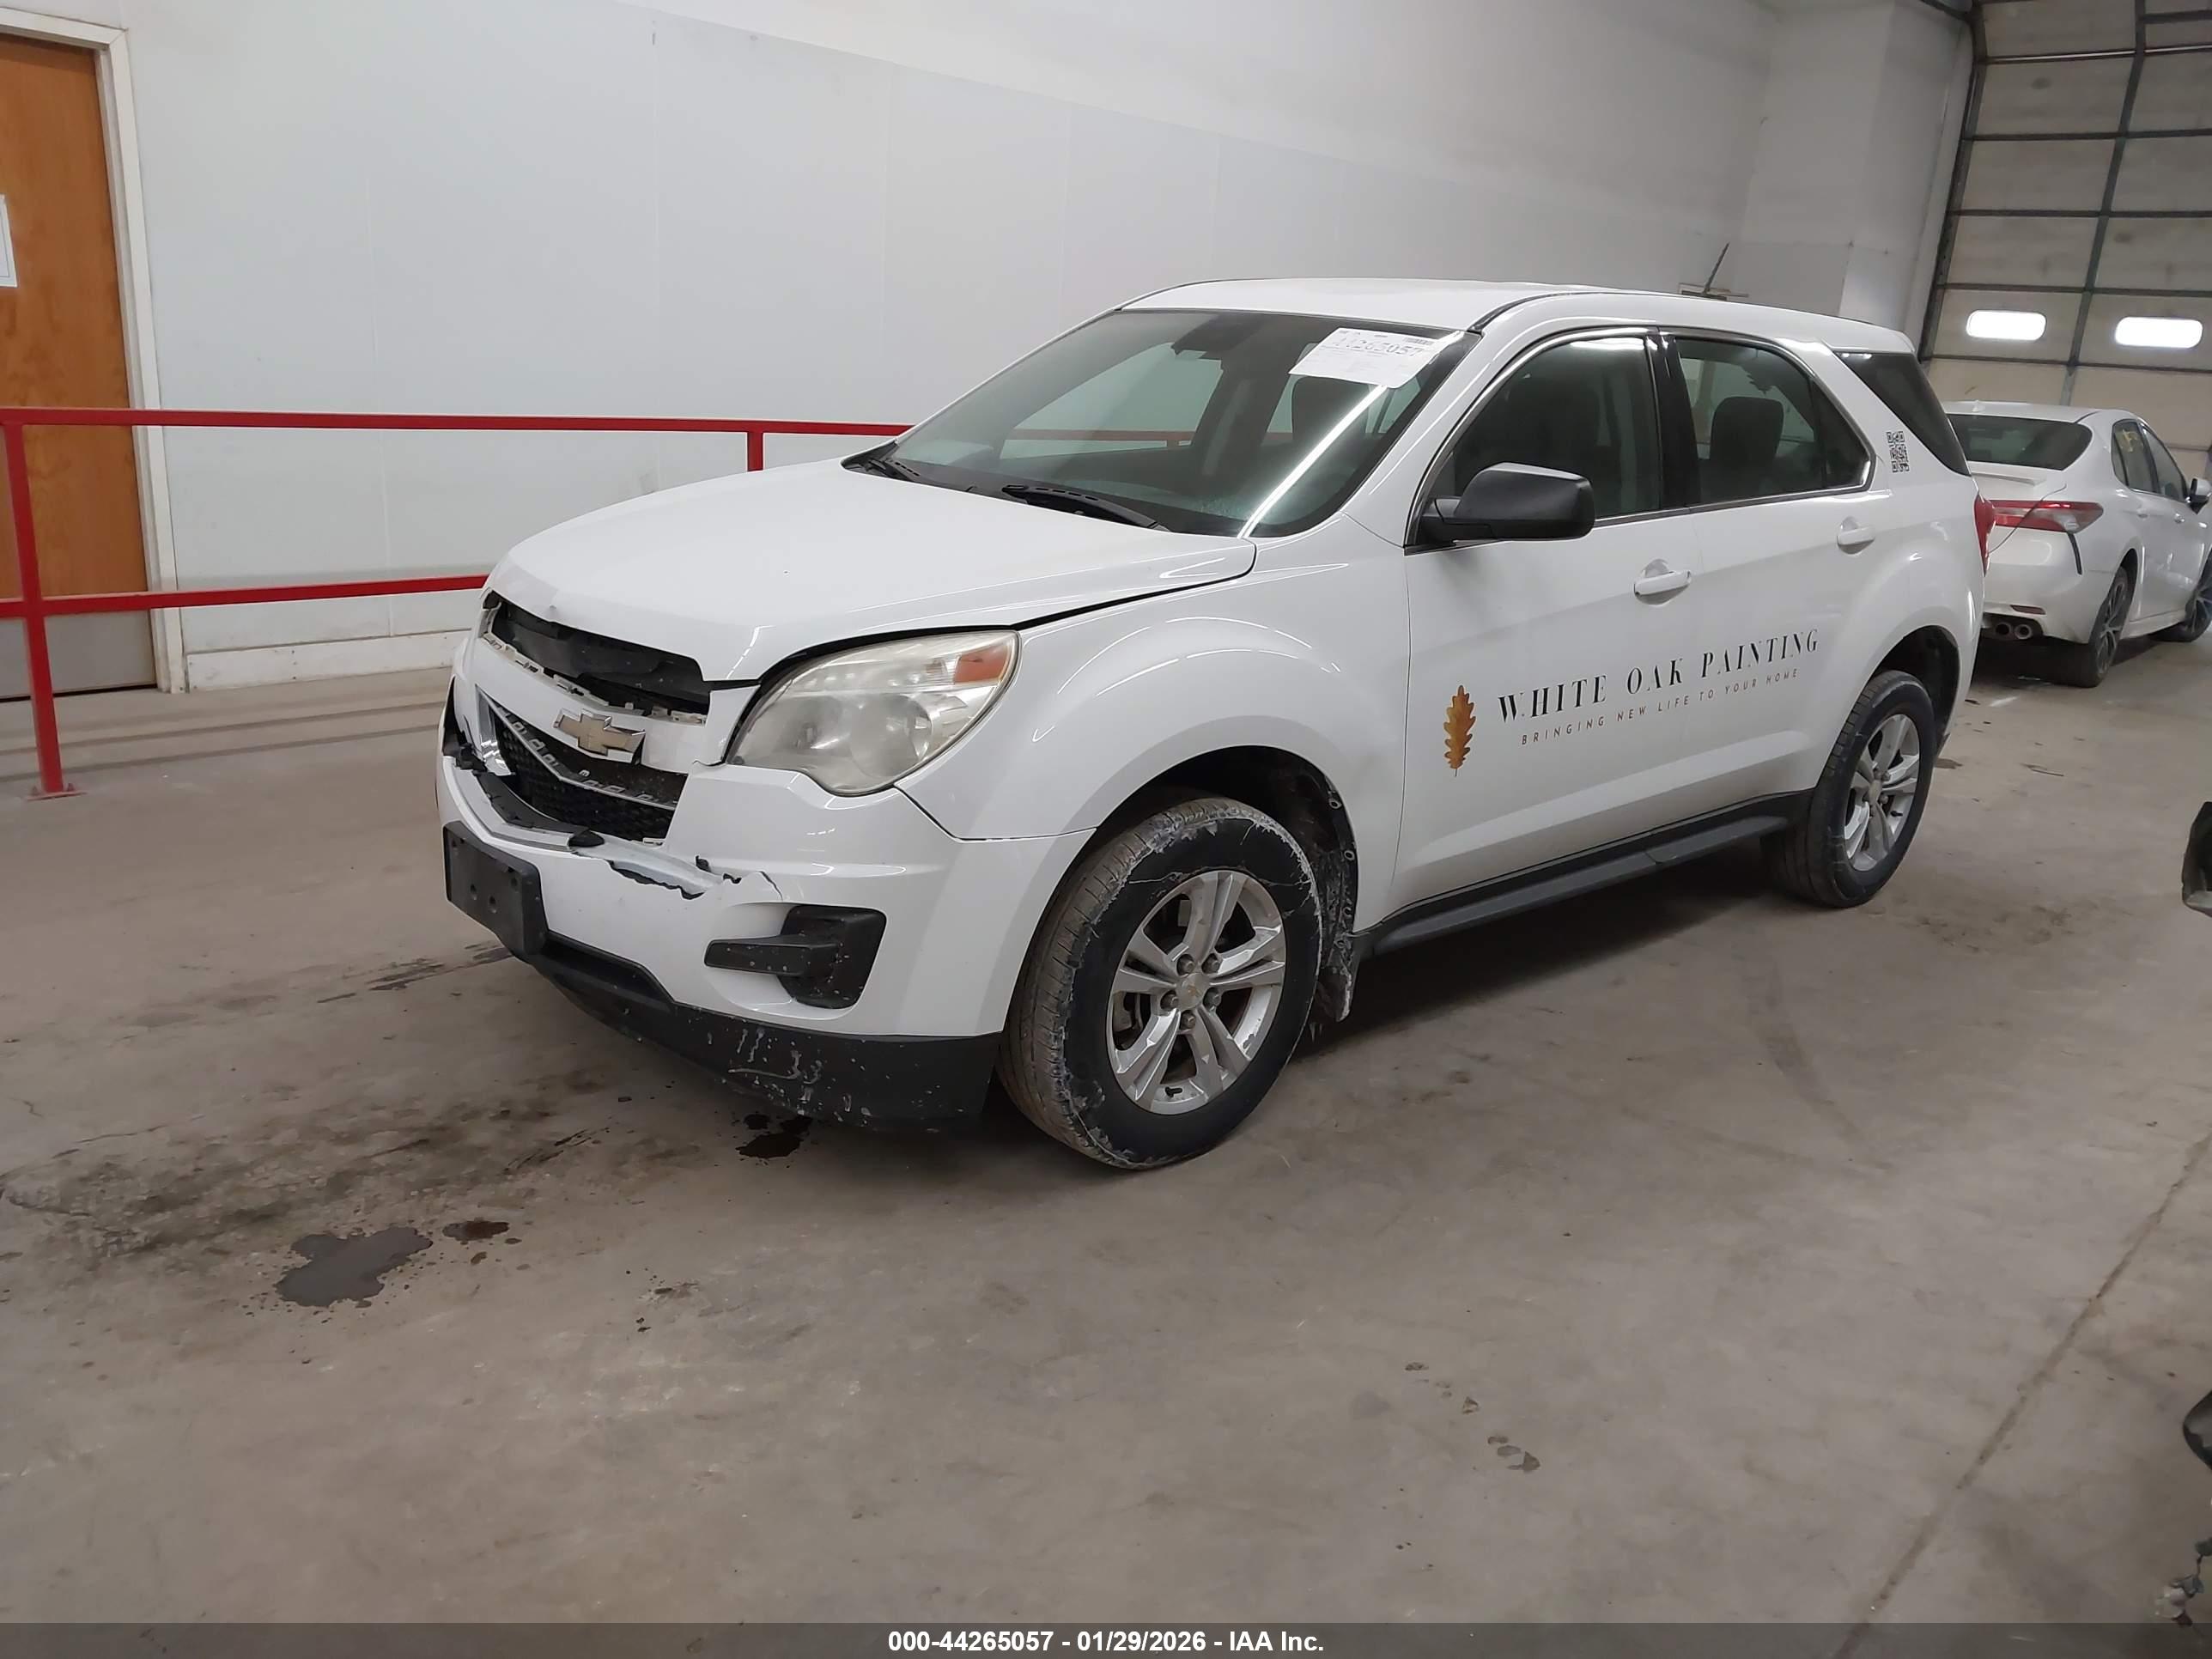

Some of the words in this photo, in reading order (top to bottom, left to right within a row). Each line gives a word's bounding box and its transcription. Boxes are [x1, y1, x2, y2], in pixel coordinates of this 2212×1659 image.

[1497, 674, 1608, 724] WHITE
[1626, 658, 1684, 696] OAK
[1700, 628, 1819, 680] PAINTING
[1521, 715, 1606, 746] BRINGING
[1617, 705, 1648, 722] NEW
[1657, 695, 1690, 712] LIFE
[1699, 689, 1715, 702] TO
[1724, 678, 1758, 695] YOUR
[1765, 668, 1798, 684] HOME
